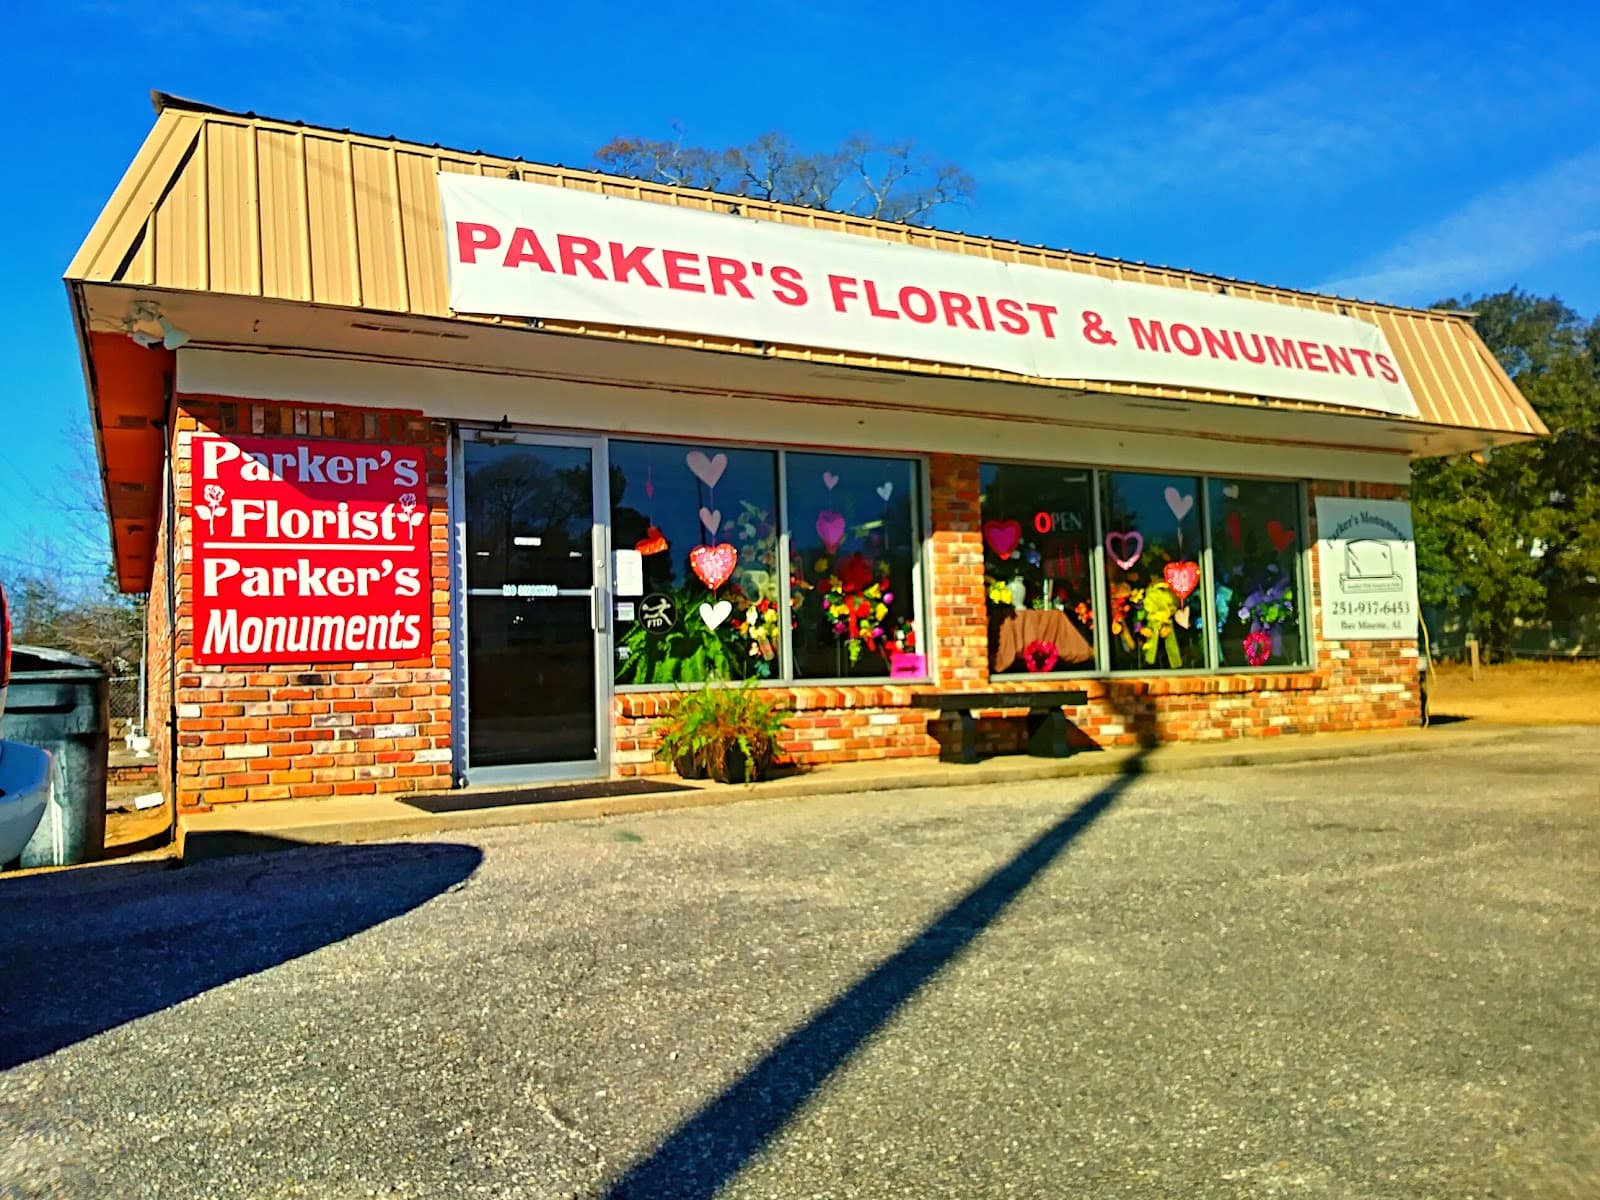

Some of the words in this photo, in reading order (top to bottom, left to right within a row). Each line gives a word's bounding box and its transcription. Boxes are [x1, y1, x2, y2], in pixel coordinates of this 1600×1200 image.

[456, 221, 808, 306] PARKER'S
[828, 274, 1058, 339] FLORIST
[1082, 310, 1116, 347] &
[1127, 316, 1399, 384] MONUMENTS
[230, 499, 397, 541] Florist
[1034, 511, 1082, 534] OPEN
[201, 609, 421, 655] Monuments
[646, 618, 663, 628] FTD
